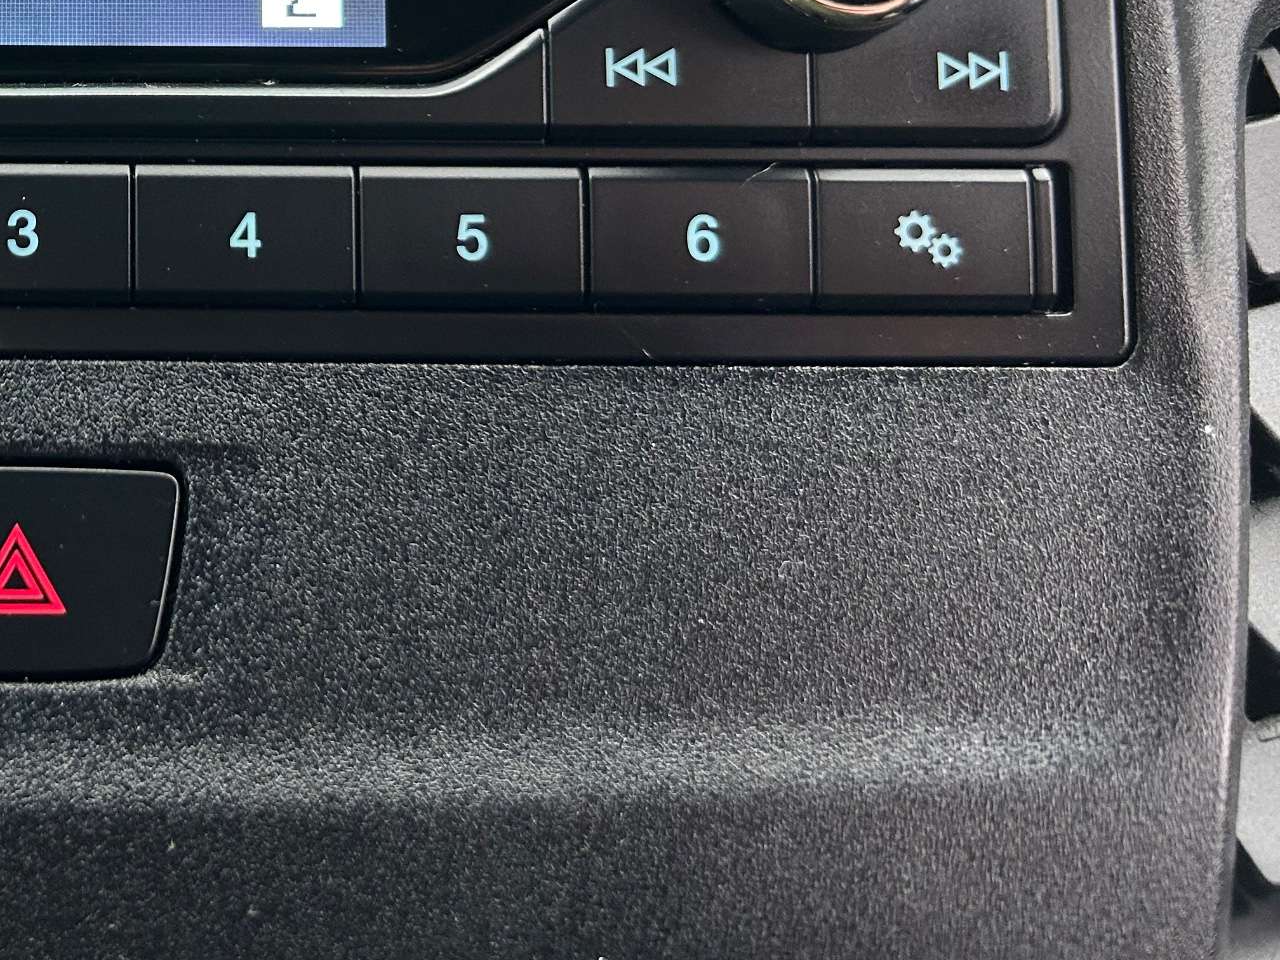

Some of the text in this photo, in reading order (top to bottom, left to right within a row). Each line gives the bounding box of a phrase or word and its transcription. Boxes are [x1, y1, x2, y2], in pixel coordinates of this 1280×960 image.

[7, 210, 39, 257] 3
[229, 211, 262, 258] 4
[456, 214, 489, 262] 5
[686, 214, 720, 262] 6
